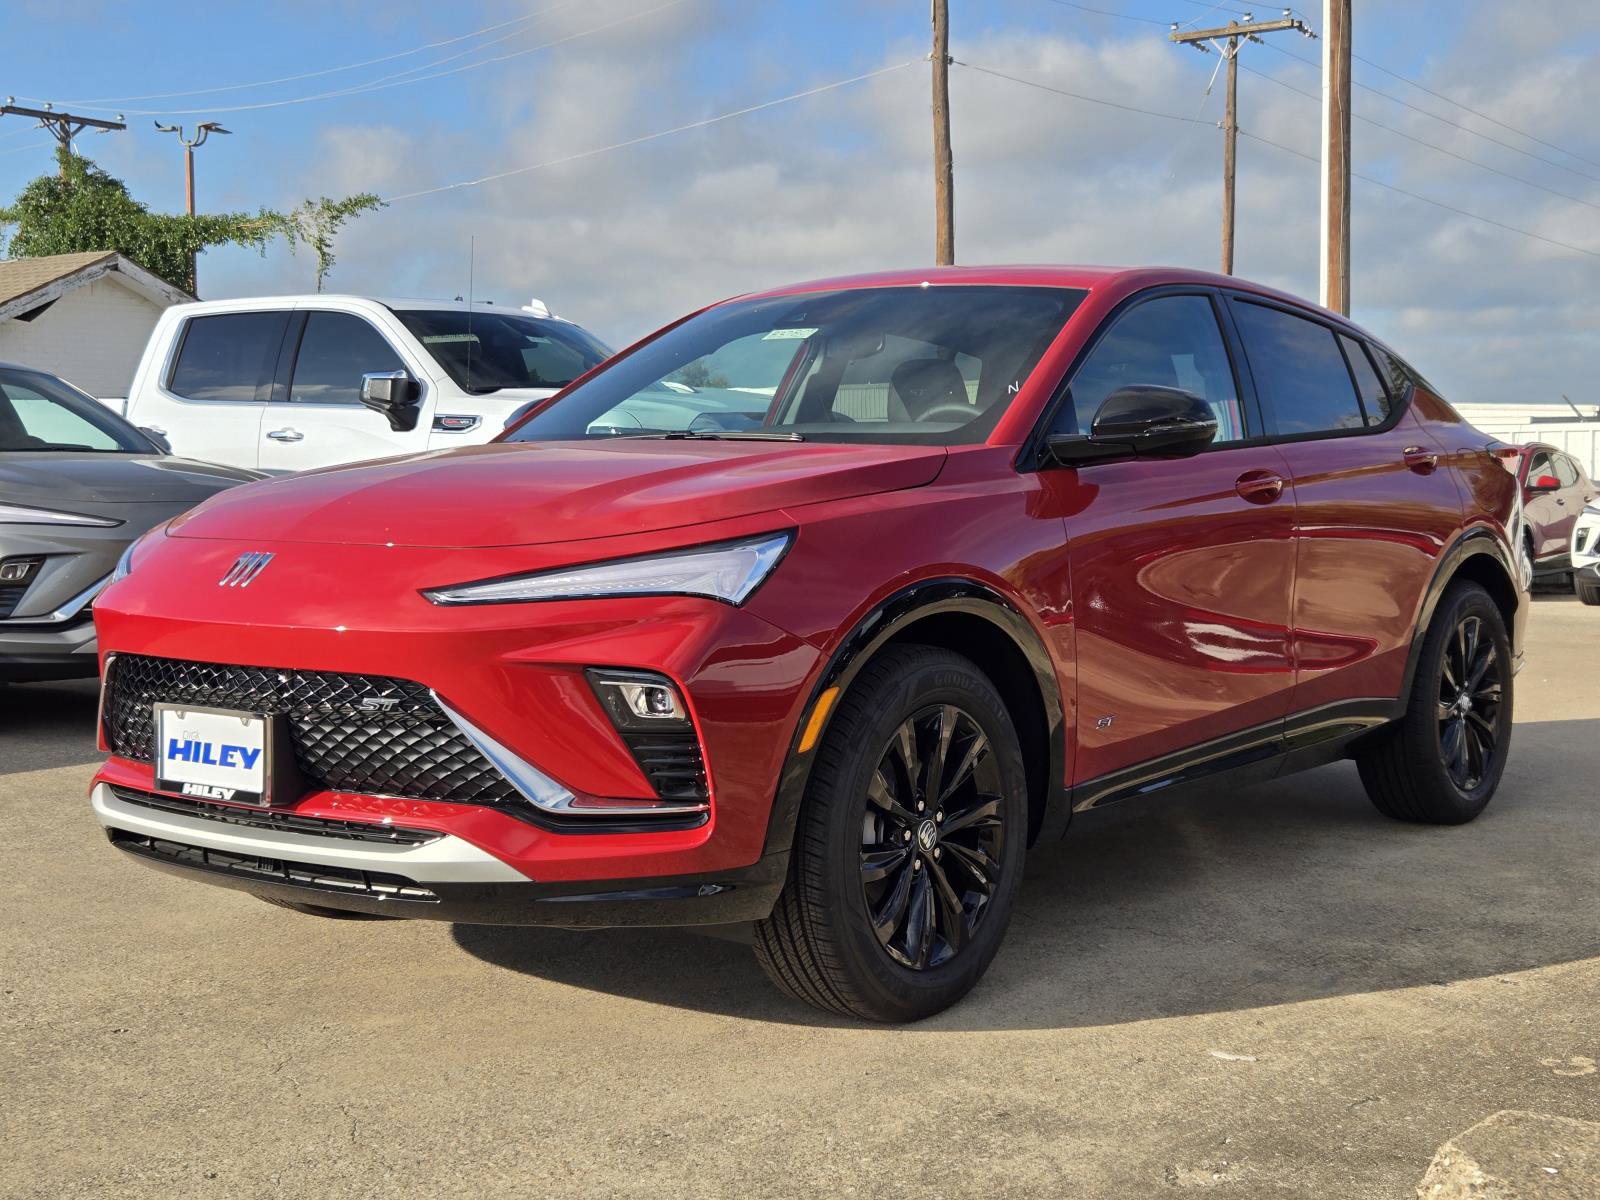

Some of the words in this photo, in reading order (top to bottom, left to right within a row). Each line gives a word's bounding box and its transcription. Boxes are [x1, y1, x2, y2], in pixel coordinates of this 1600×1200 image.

[360, 697, 400, 711] ST
[168, 738, 262, 770] HILEY
[182, 783, 236, 801] HILEY
